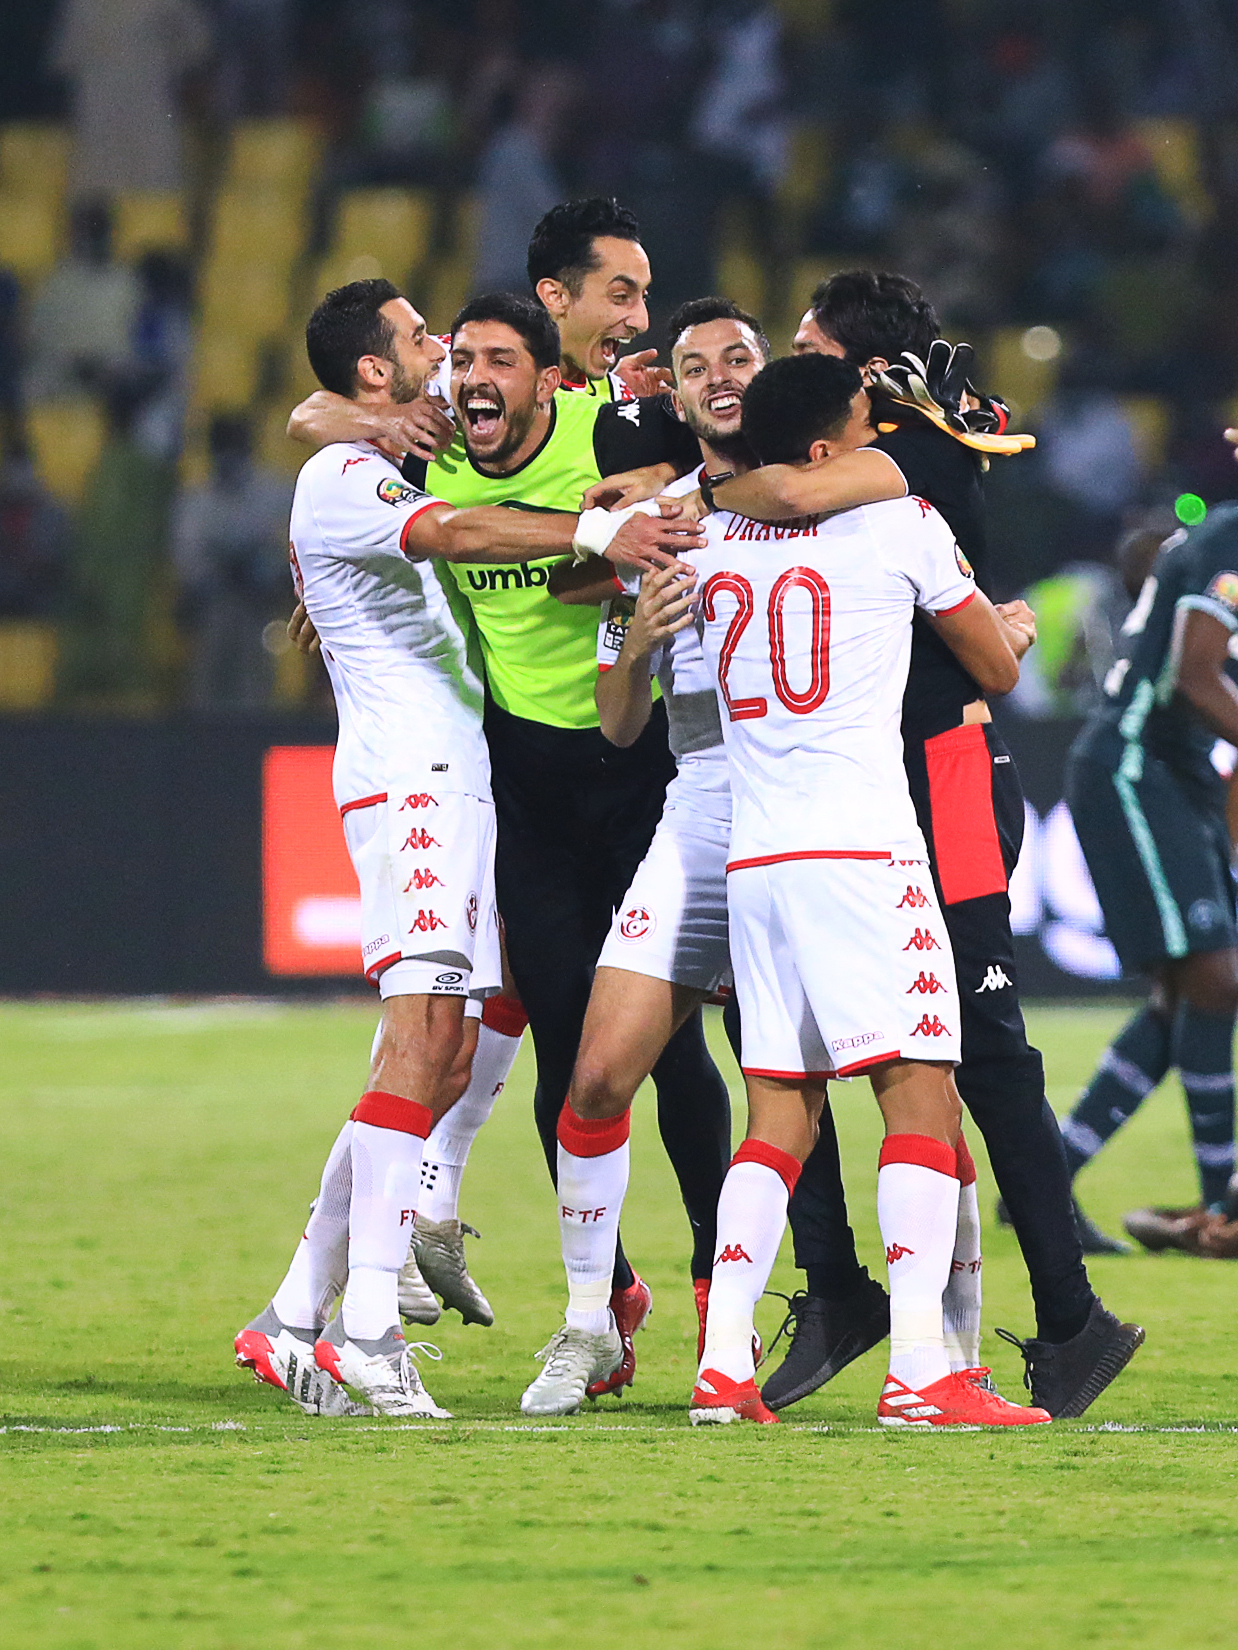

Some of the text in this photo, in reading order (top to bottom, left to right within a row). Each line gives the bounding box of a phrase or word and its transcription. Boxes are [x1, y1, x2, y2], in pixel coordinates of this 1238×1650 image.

[466, 562, 555, 591] umb
[703, 565, 831, 722] 20
[362, 933, 390, 957] appa
[831, 1030, 885, 1052] Kappa
[562, 1205, 607, 1223] FTF
